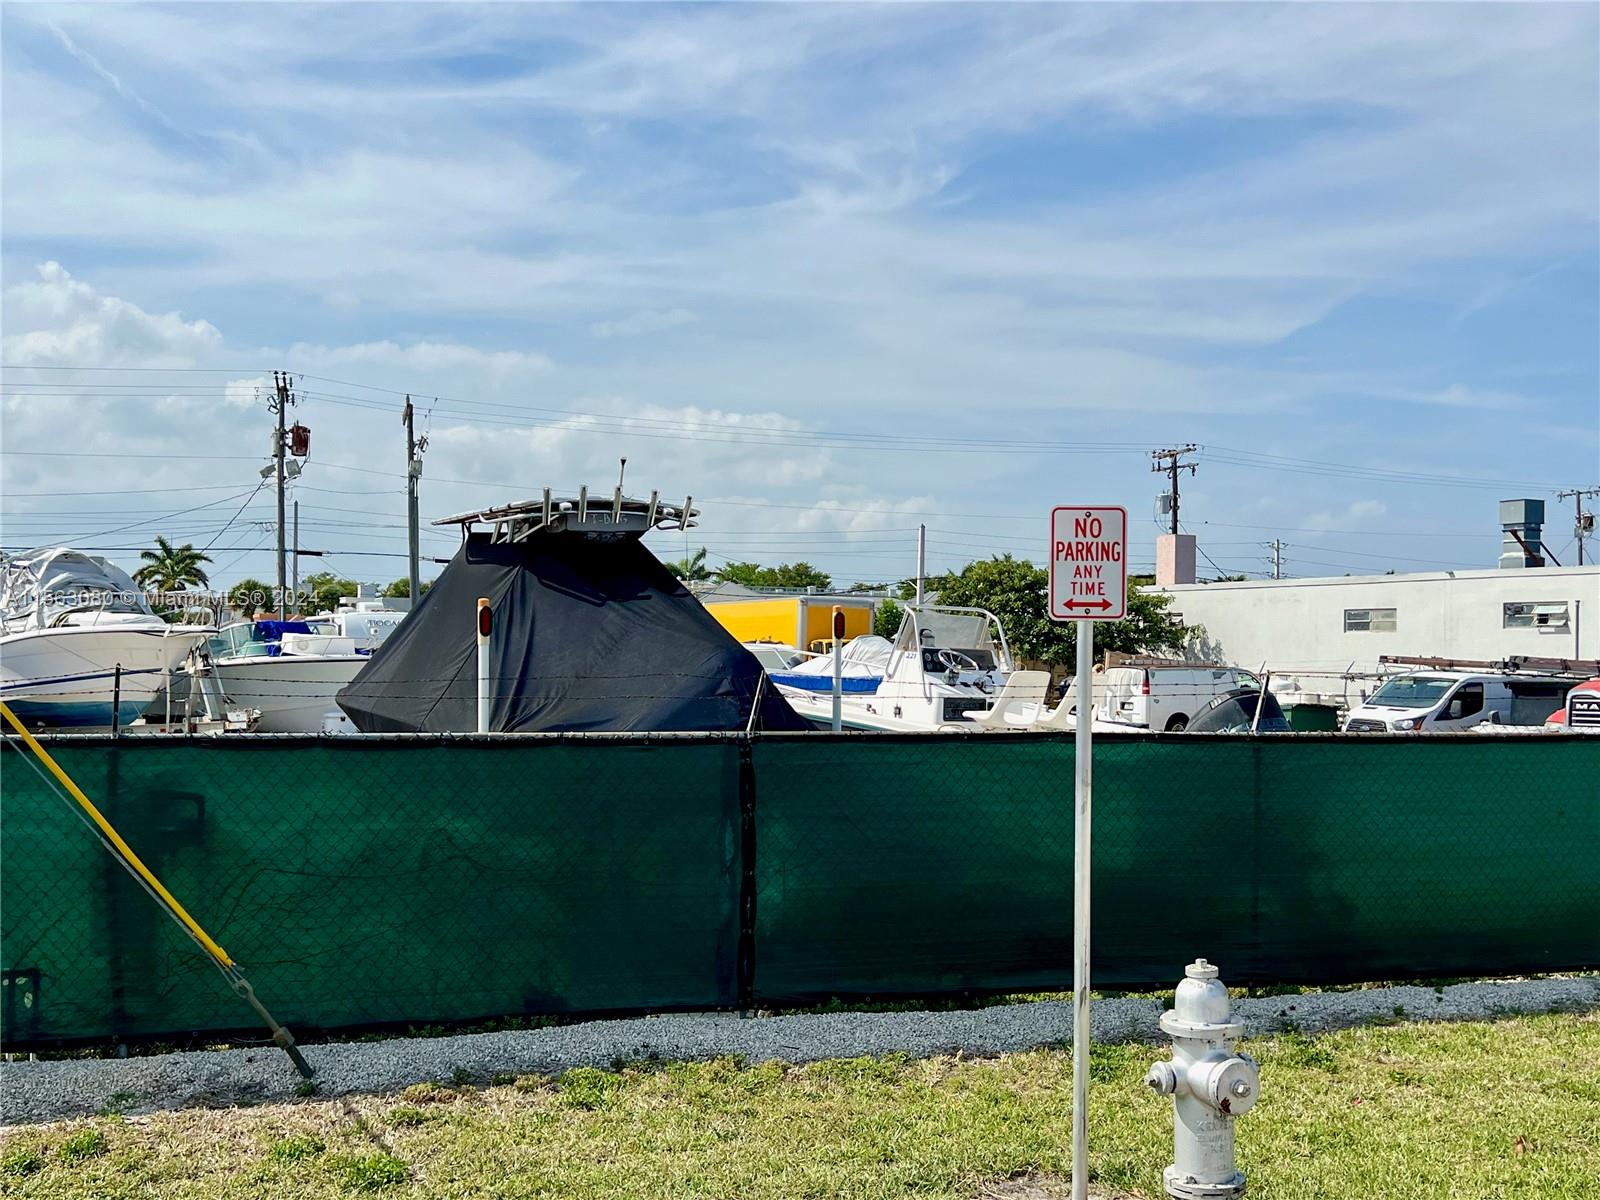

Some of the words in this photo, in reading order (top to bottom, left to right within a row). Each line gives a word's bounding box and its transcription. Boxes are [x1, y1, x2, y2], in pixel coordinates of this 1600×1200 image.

[1074, 518, 1102, 539] NO
[1055, 541, 1121, 562] PARKING
[1073, 564, 1103, 579] ANY
[1070, 581, 1106, 596] TIME
